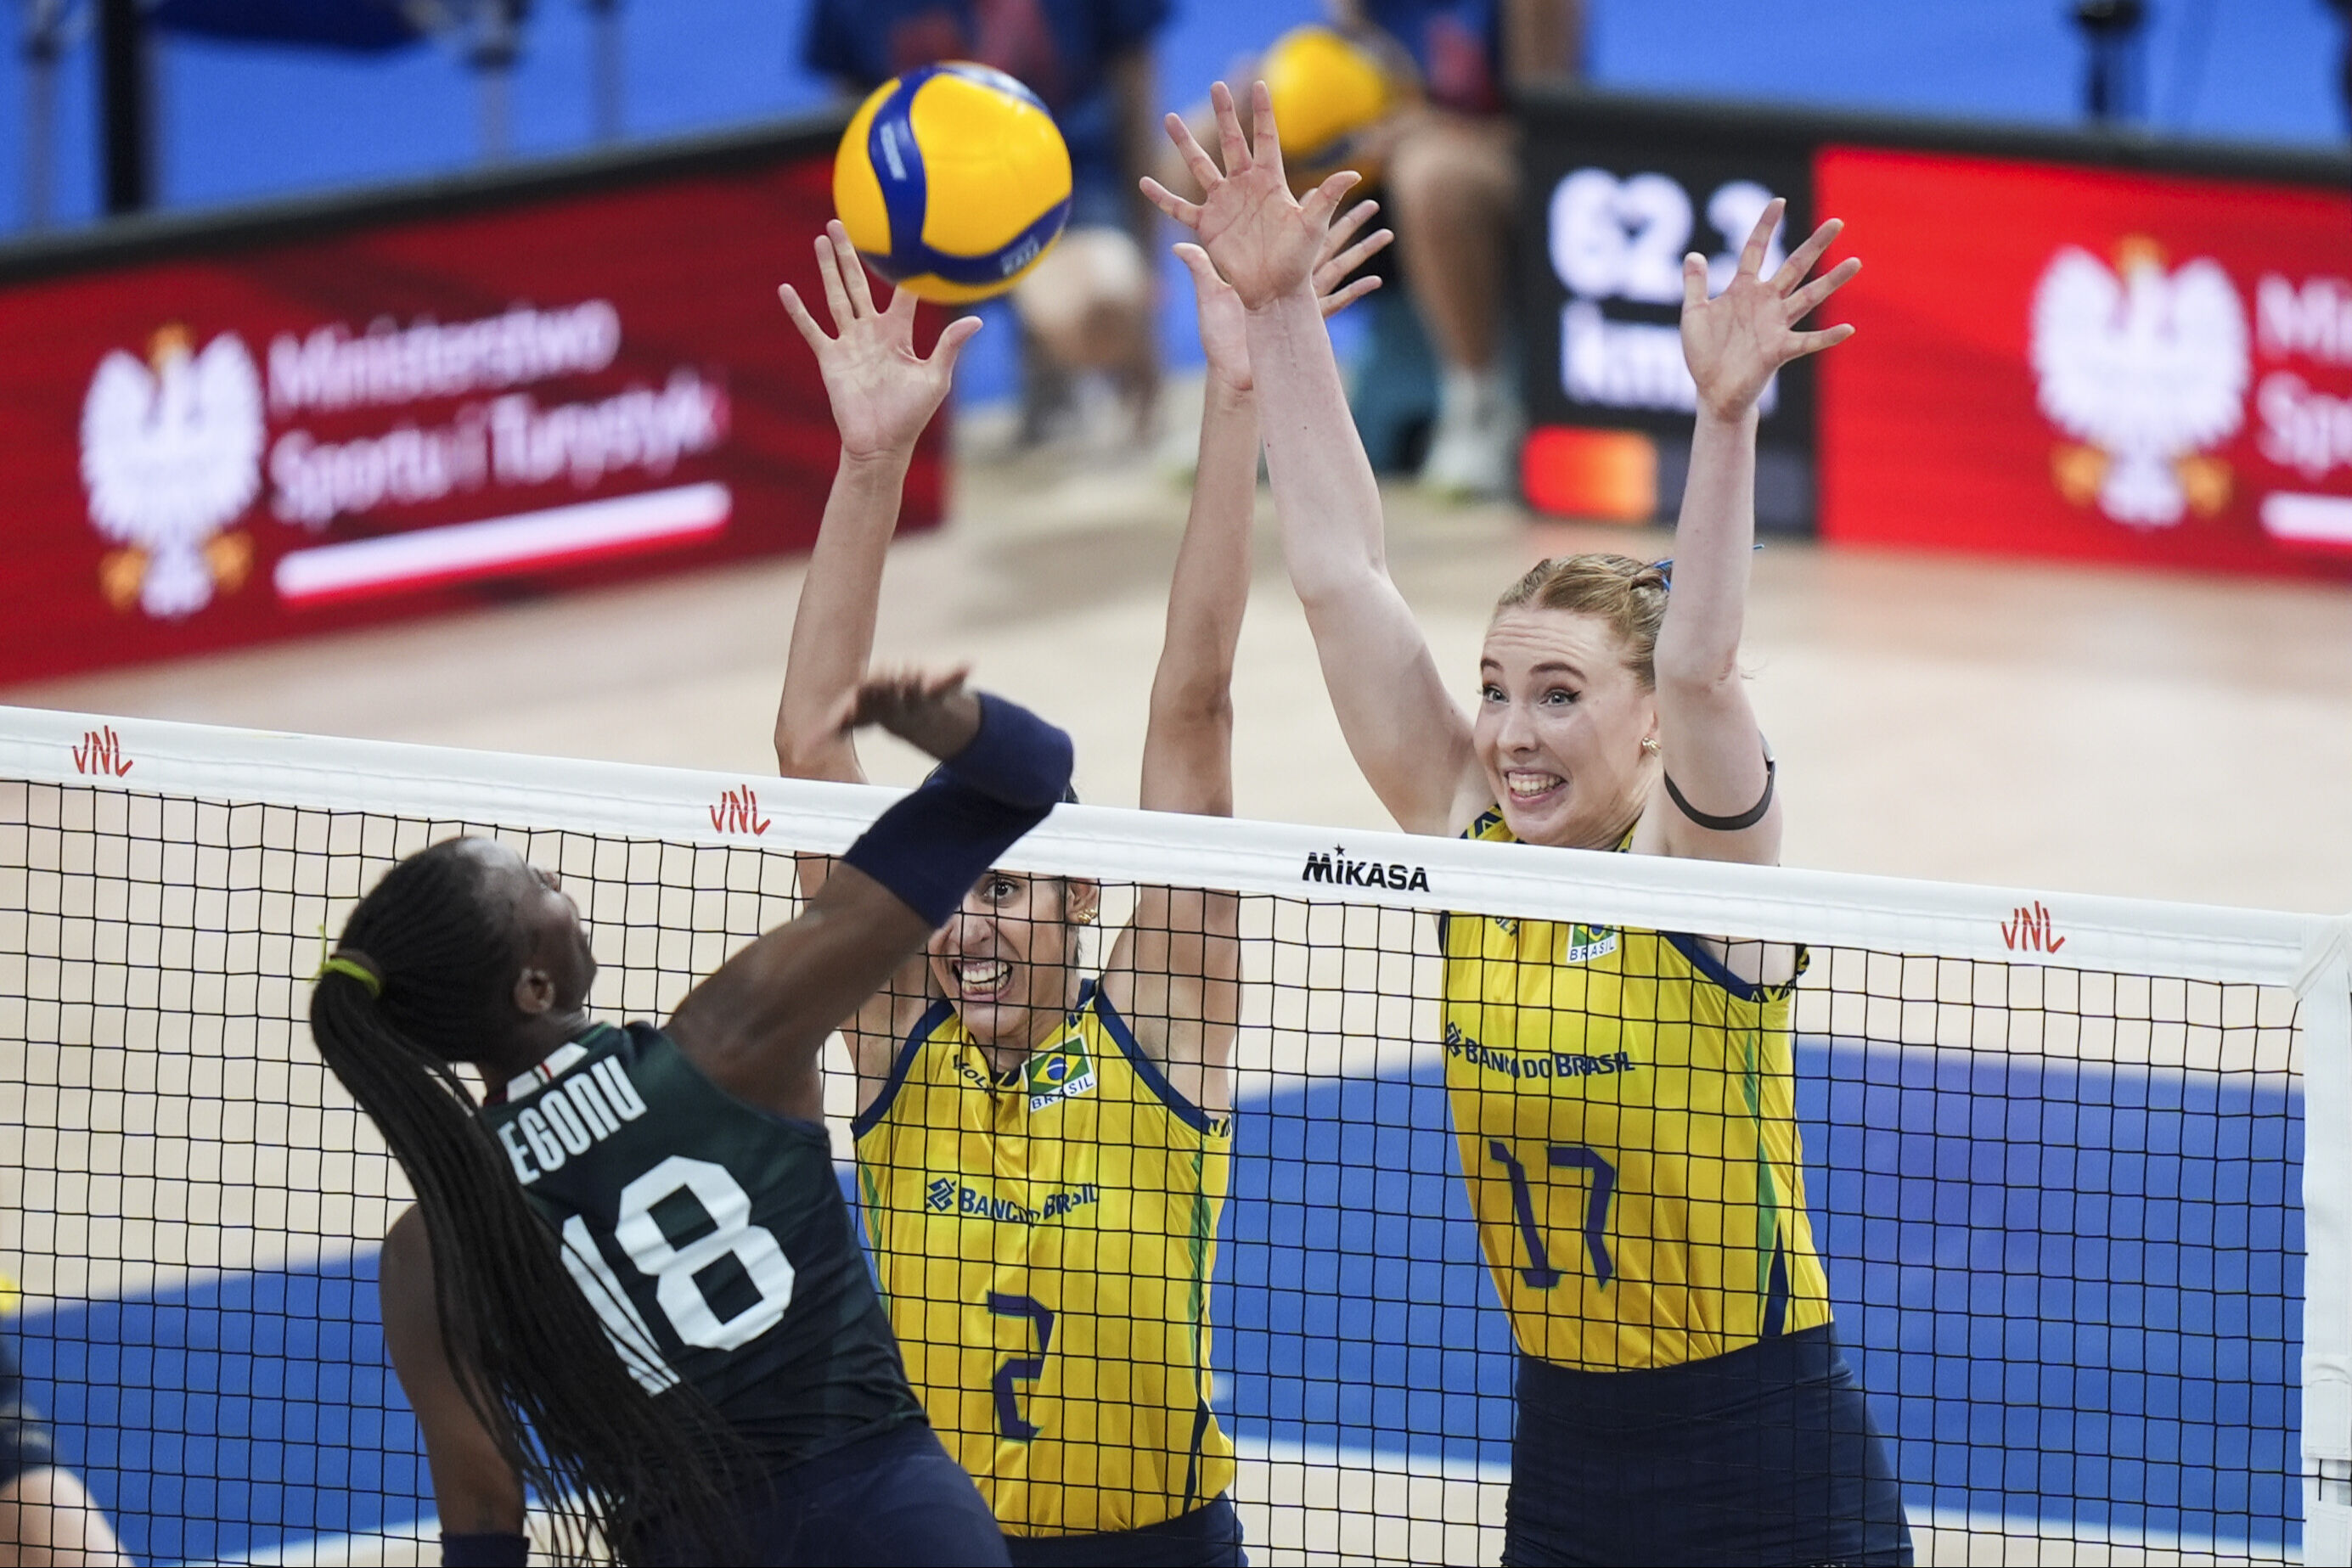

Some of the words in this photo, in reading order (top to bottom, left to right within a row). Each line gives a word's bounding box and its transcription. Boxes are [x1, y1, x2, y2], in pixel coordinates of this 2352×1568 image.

[1550, 170, 1786, 304] 623
[72, 724, 133, 777] VNL
[709, 784, 771, 836] VNL
[1570, 941, 1615, 961] BRASIL
[2000, 900, 2065, 953] VNL
[1523, 1059, 1551, 1079] DO
[1555, 1052, 1635, 1077] BRASIL
[498, 1054, 648, 1185] EGONU
[1031, 1079, 1094, 1110] BRASIL
[1044, 1182, 1098, 1220] BRSIL
[1489, 1139, 1618, 1292] 17
[987, 1290, 1055, 1444] 2
